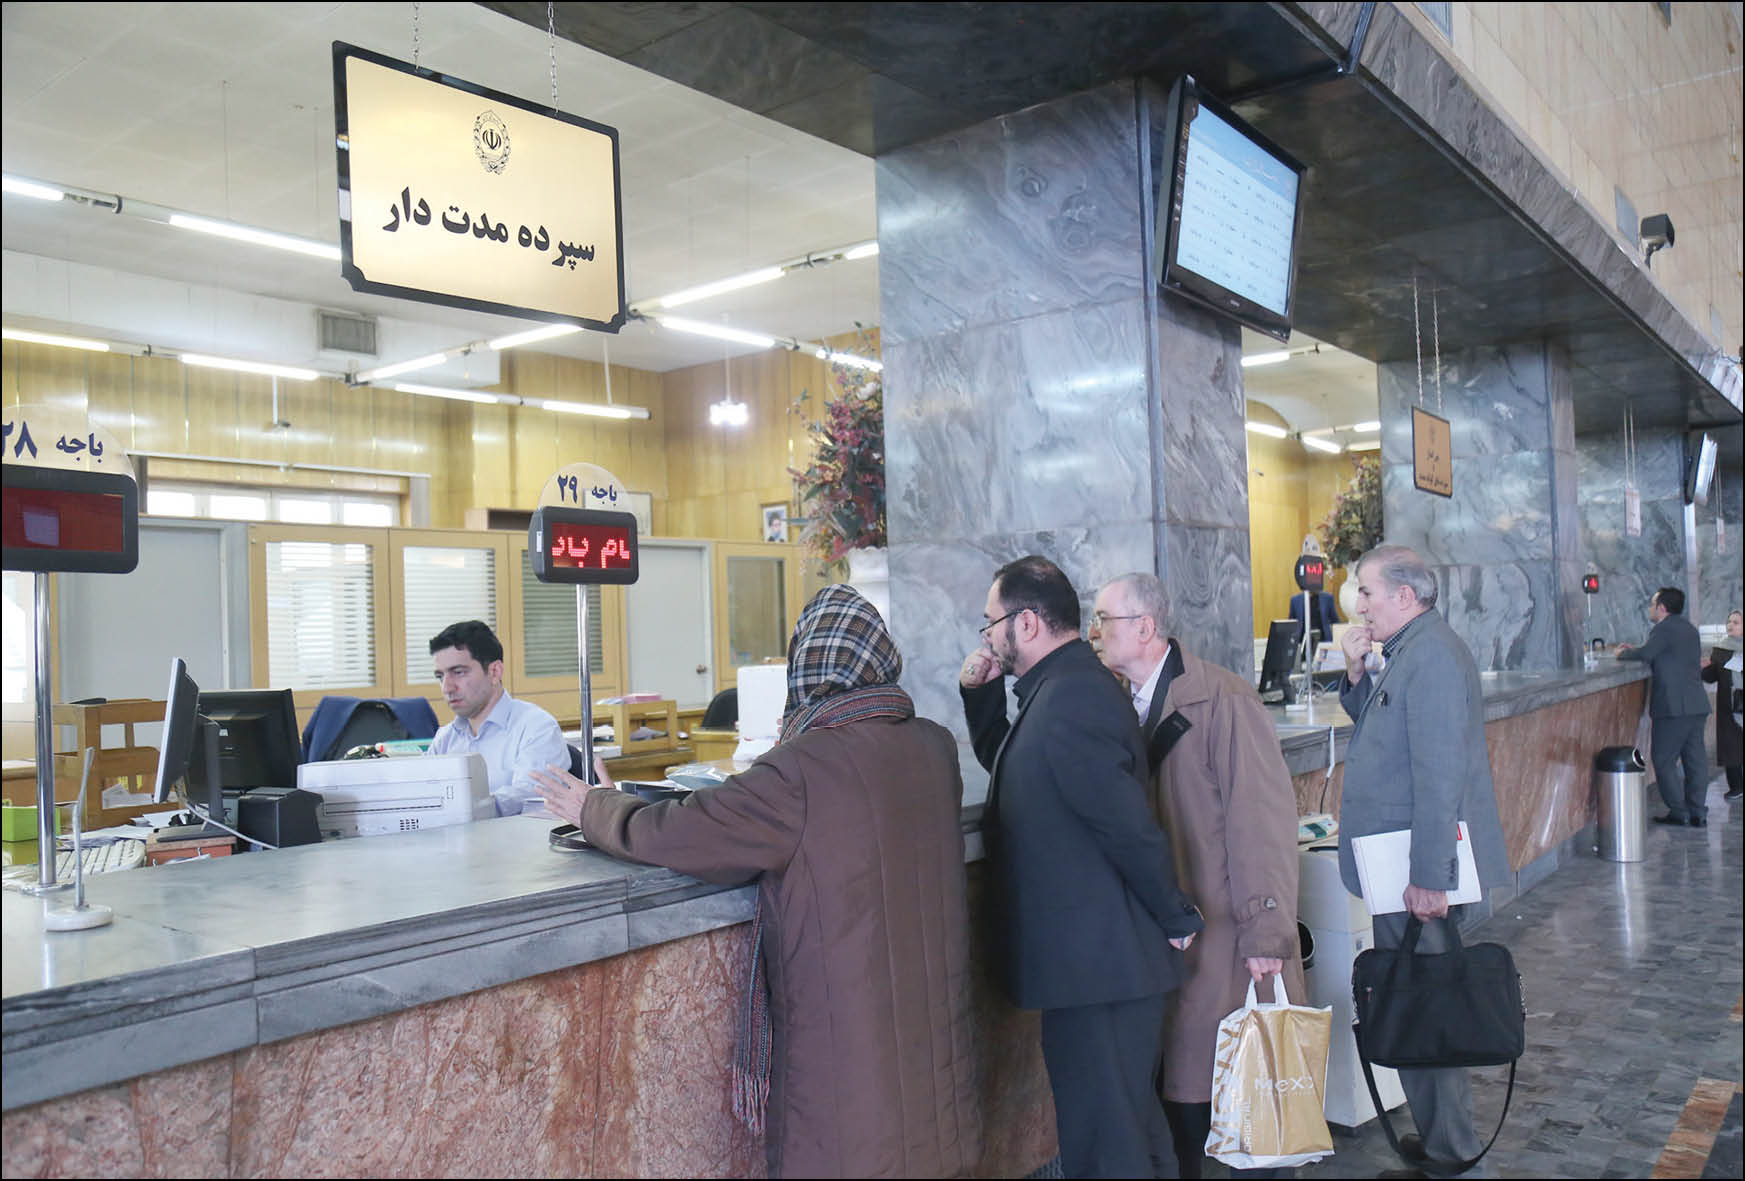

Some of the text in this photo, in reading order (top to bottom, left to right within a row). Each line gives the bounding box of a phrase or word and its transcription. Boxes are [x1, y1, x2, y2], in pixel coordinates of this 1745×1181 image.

[382, 187, 432, 232] دار
[441, 204, 509, 243] مدت
[55, 433, 104, 464] باجه
[557, 474, 618, 506] باجه ۲۹
